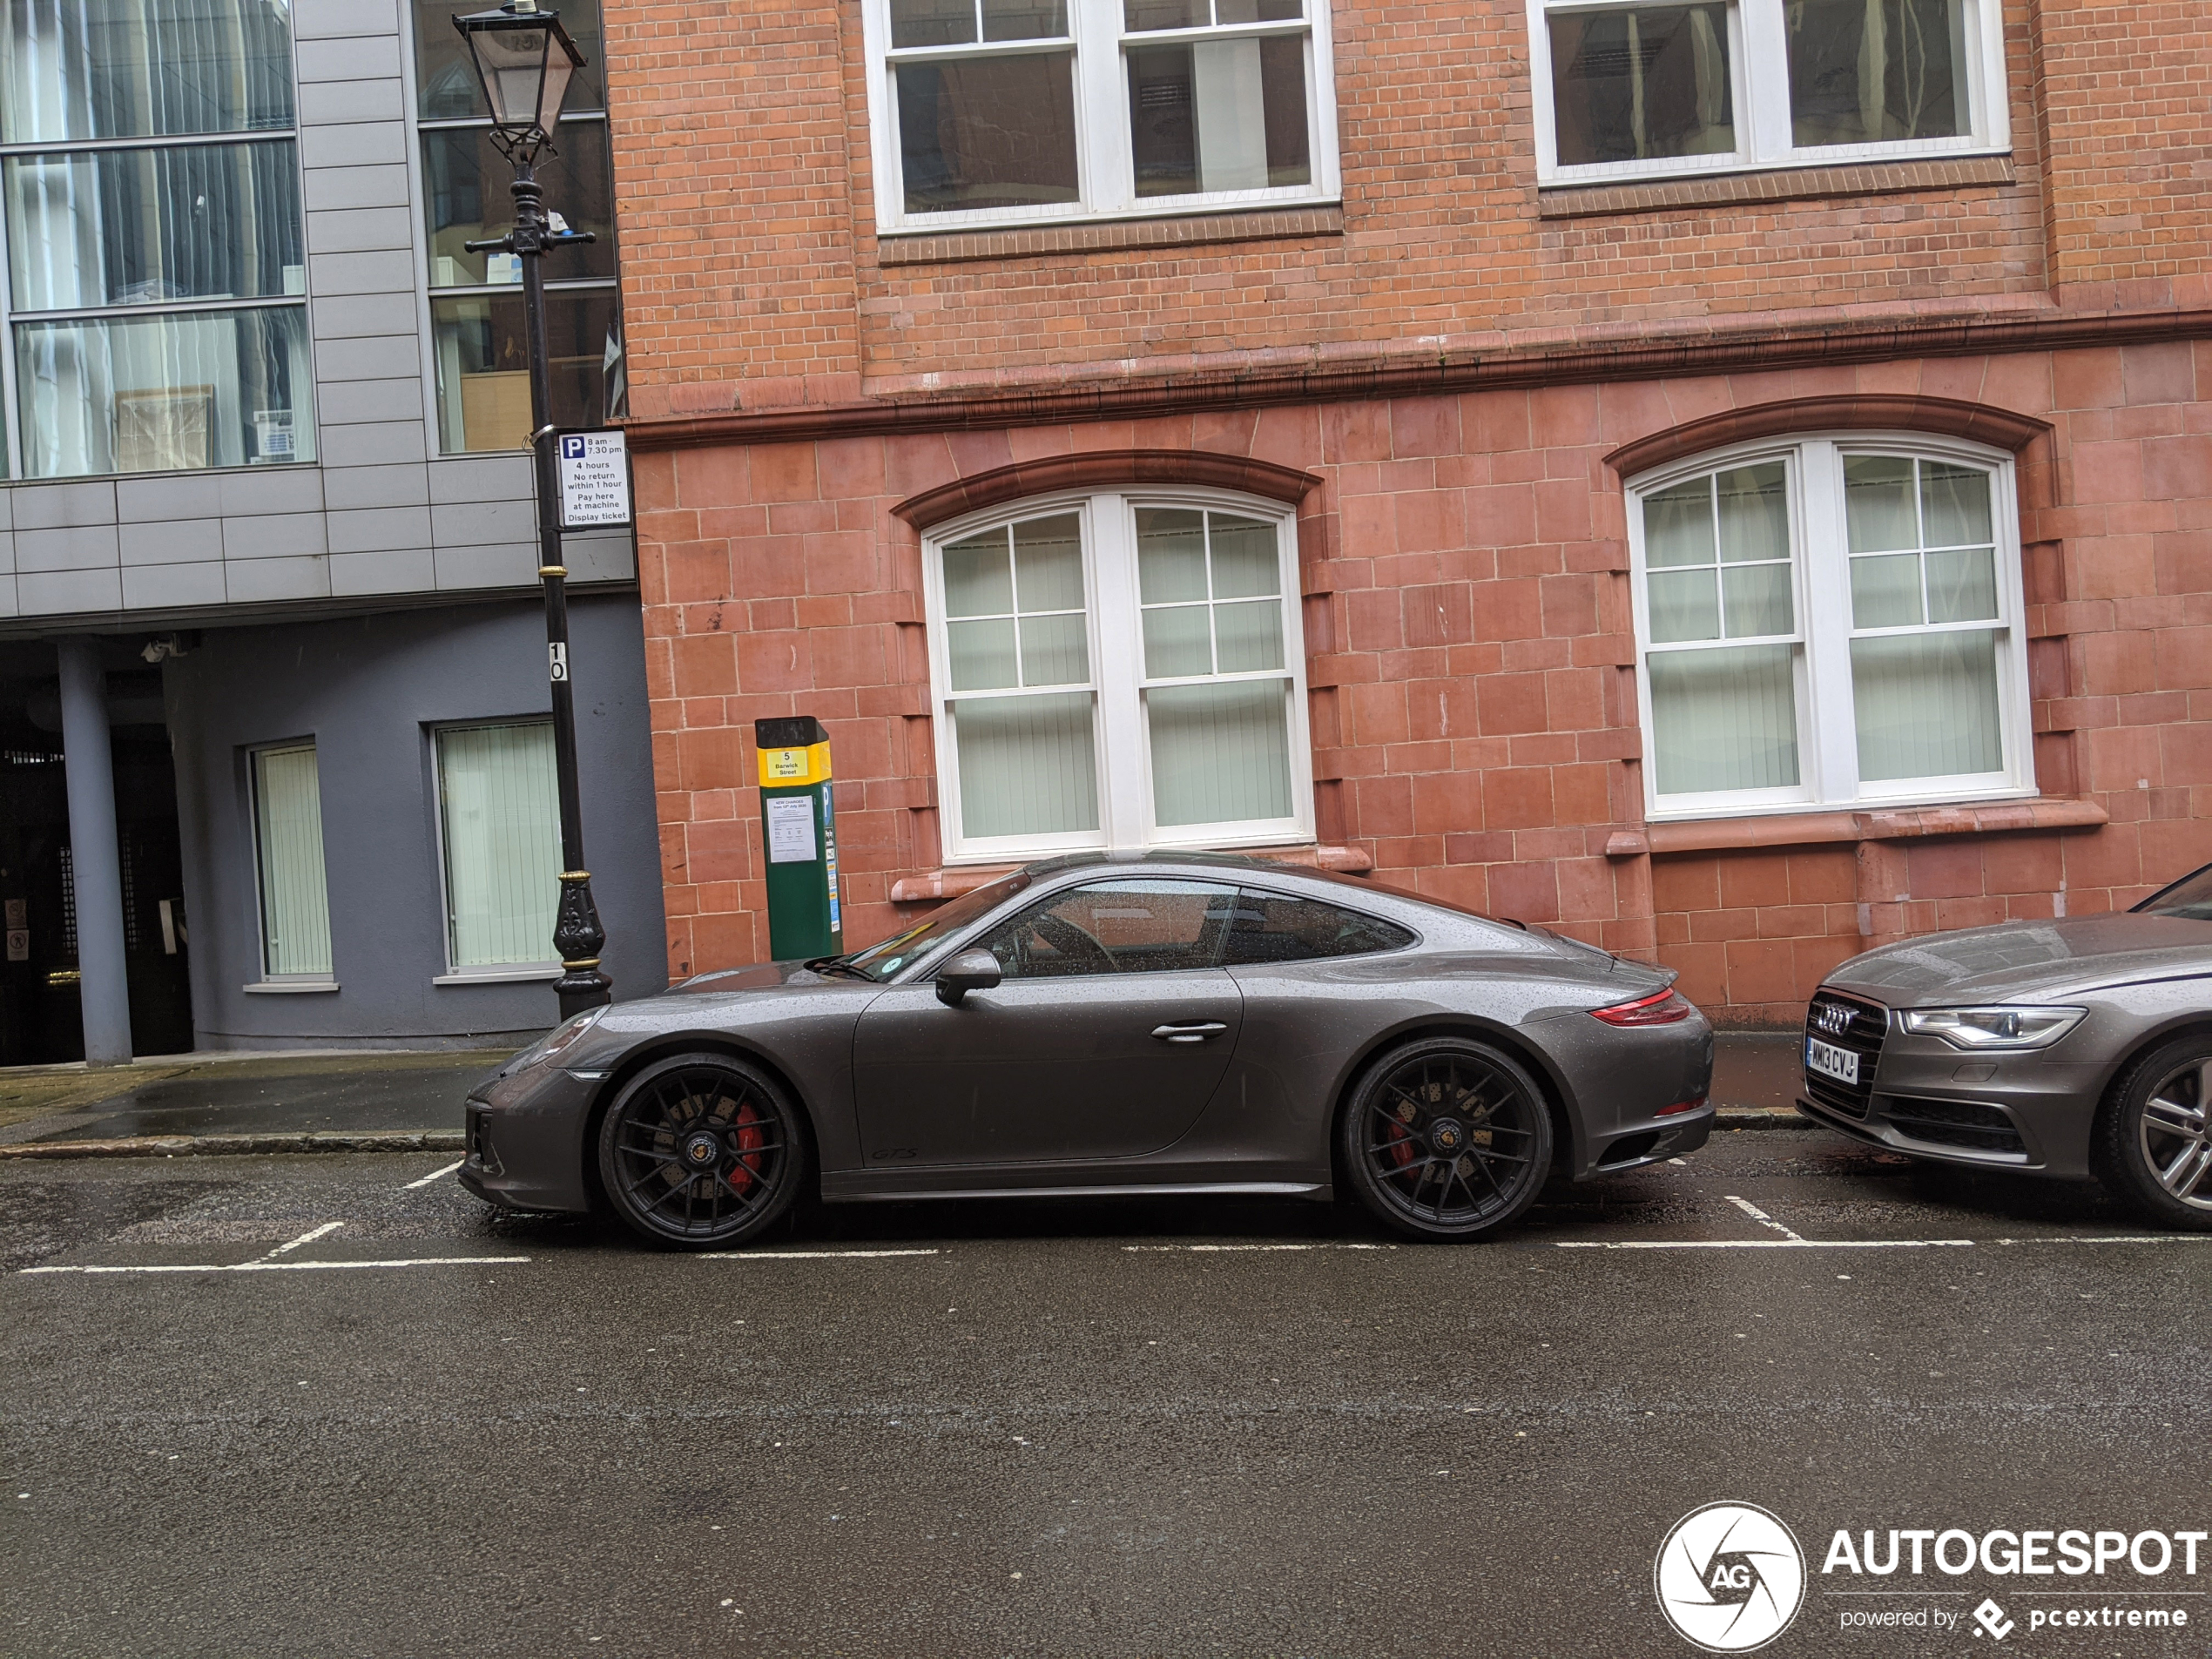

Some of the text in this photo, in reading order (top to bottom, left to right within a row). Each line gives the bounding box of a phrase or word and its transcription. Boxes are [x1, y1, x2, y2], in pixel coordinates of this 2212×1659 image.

[567, 438, 583, 457] P
[567, 482, 594, 490] within
[603, 480, 622, 489] hour
[577, 492, 615, 502] Pay here
[584, 501, 620, 509] machine
[568, 511, 627, 523] Display ticket
[784, 752, 790, 760] 5
[872, 1148, 918, 1159] GTS
